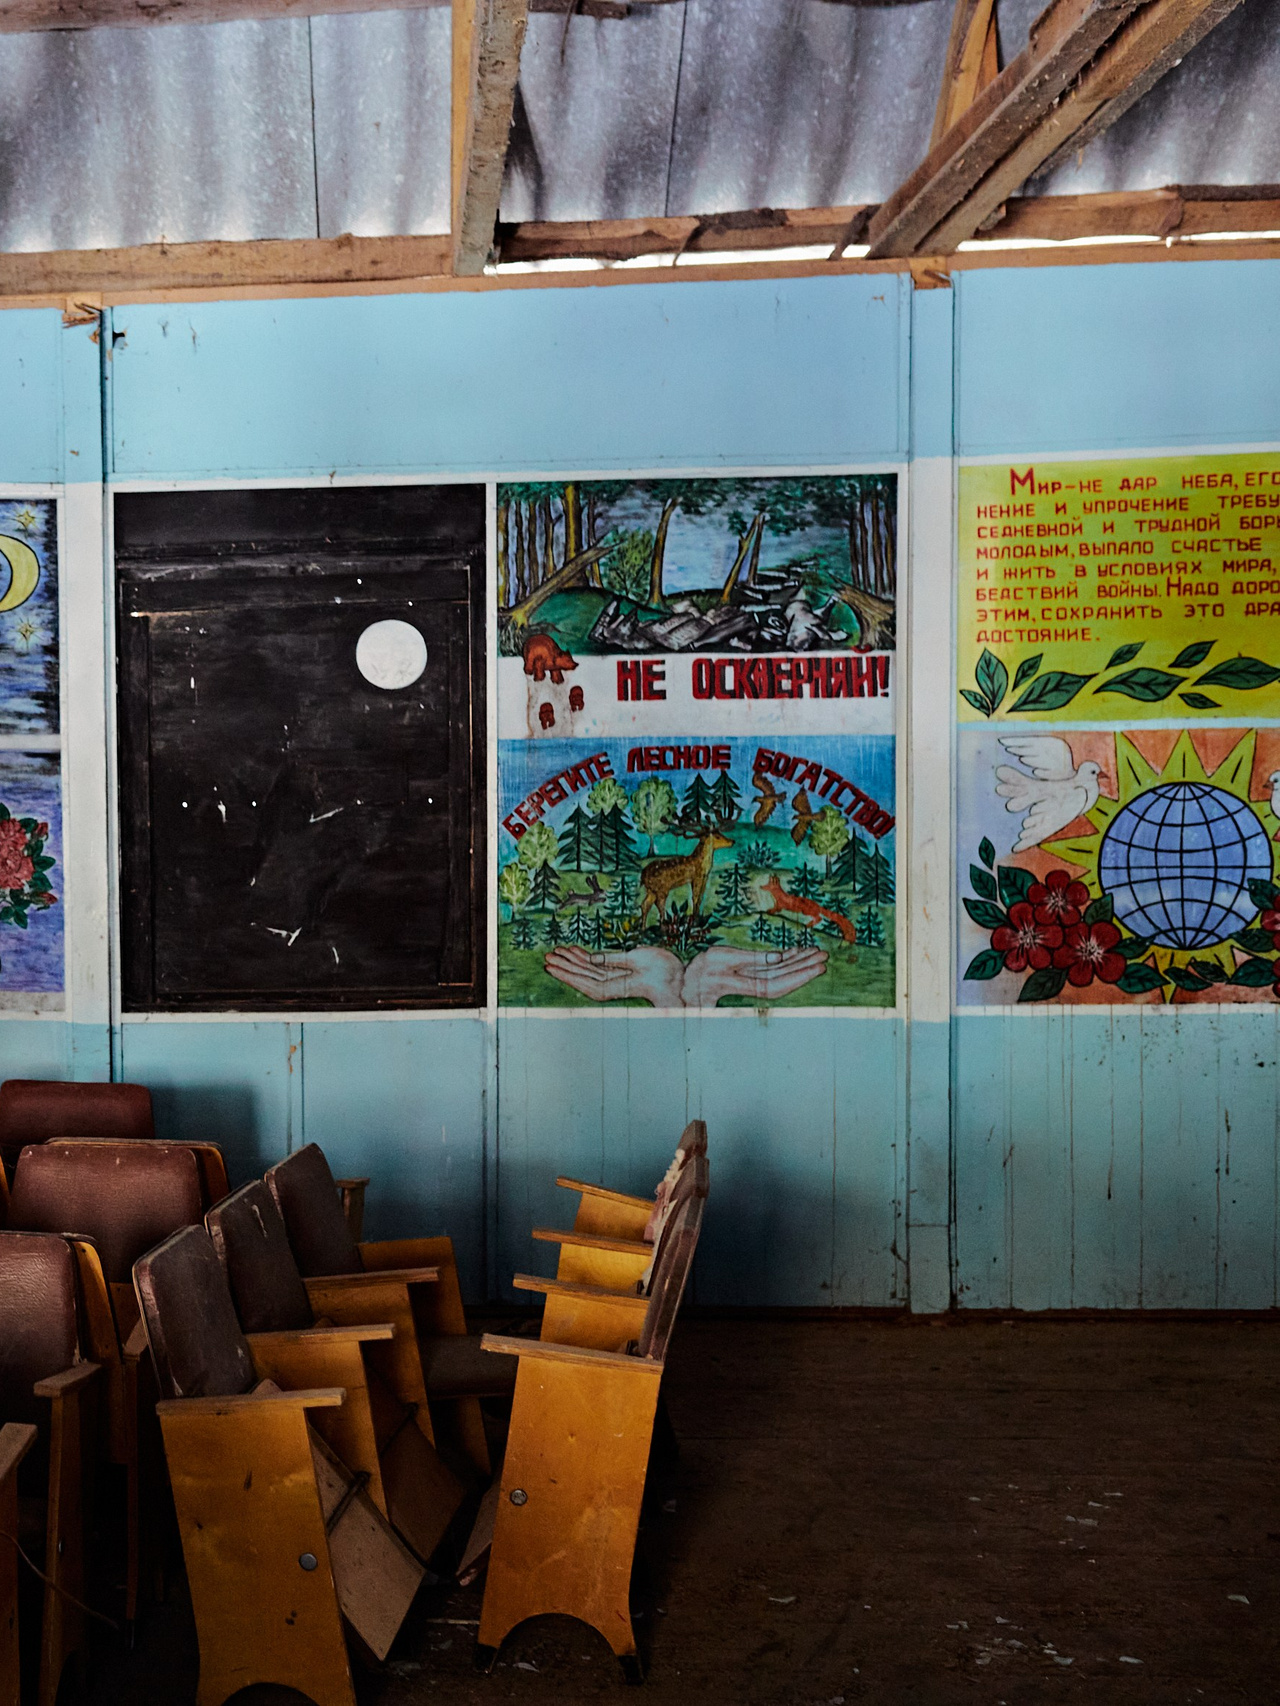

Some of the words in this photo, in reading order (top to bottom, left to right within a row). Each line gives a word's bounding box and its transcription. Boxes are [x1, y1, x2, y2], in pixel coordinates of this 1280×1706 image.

[1119, 476, 1158, 492] ДАР
[1181, 473, 1239, 491] НЕБА,
[1245, 471, 1280, 487] ЕГО
[976, 503, 1036, 519] НЕНИЕ
[1055, 502, 1067, 515] И
[1083, 497, 1190, 515] УПРОЧЕНИЕ
[1217, 494, 1280, 509] ТРЕБУ
[976, 516, 1084, 539] СЕДНЕВНОЙ
[1103, 521, 1115, 534] И
[1134, 513, 1221, 534] ТРУДНОЙ
[976, 544, 1075, 560] МОЛОДЫМ,
[1079, 541, 1154, 556] ВЫПАЛО
[1171, 537, 1262, 554] СЧАСТЬЕ
[976, 567, 988, 581] И
[1003, 566, 1056, 581] ЖИТЬ
[1074, 564, 1087, 578] В
[1097, 561, 1202, 578] УСЛОВИЯХ
[1222, 558, 1277, 576] МИРА,
[976, 580, 1078, 601] БЕДСТВИЙ
[1097, 579, 1162, 599] ВОЙНЫ.
[1166, 576, 1219, 597] НАДО
[1231, 580, 1280, 595] ДОРО
[976, 607, 1037, 626] ЭТИМ,
[1041, 604, 1163, 621] СОХРАНИТЬ
[1184, 603, 1225, 618] ЭТО
[1244, 601, 1280, 617] ДРА
[976, 627, 1101, 644] ДОСТОЯНИЕ.
[617, 659, 667, 701] НЕ
[692, 645, 890, 700] ОСКВЕРНЯЙ!
[501, 751, 615, 842] БЕРЕГИТЕ
[626, 745, 732, 774] ЛЕСНОЕ
[752, 747, 896, 841] БОГАТСТВО!
